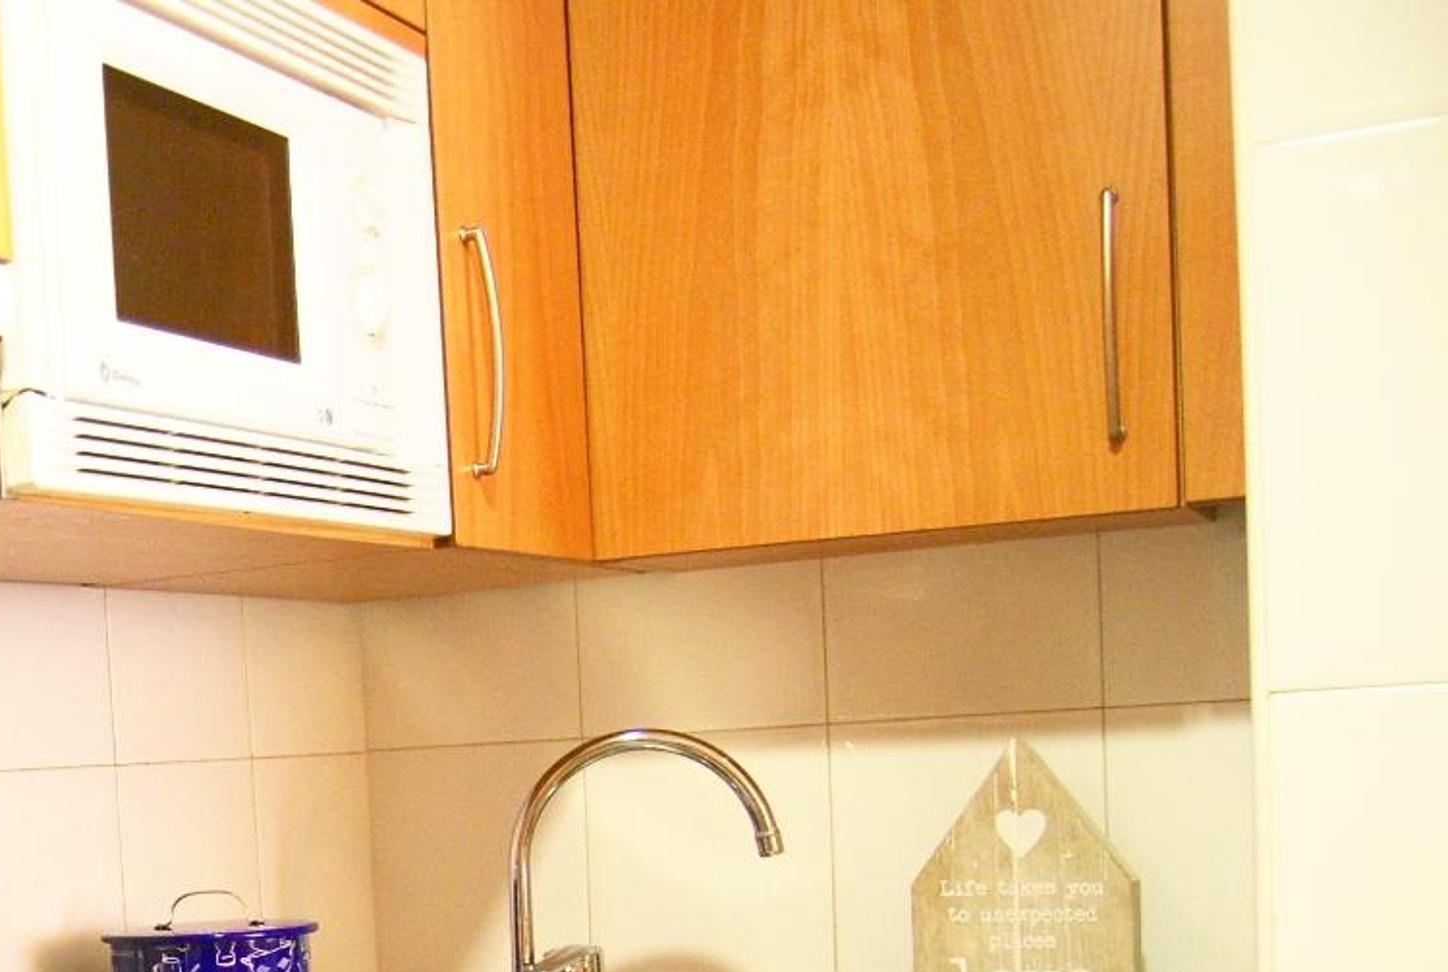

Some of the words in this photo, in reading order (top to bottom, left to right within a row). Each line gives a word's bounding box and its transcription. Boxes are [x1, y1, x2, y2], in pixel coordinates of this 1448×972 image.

[938, 879, 989, 897] Life
[997, 879, 1056, 897] takes
[1065, 881, 1105, 900] you
[947, 907, 971, 924] to
[980, 906, 1099, 926] unexpected
